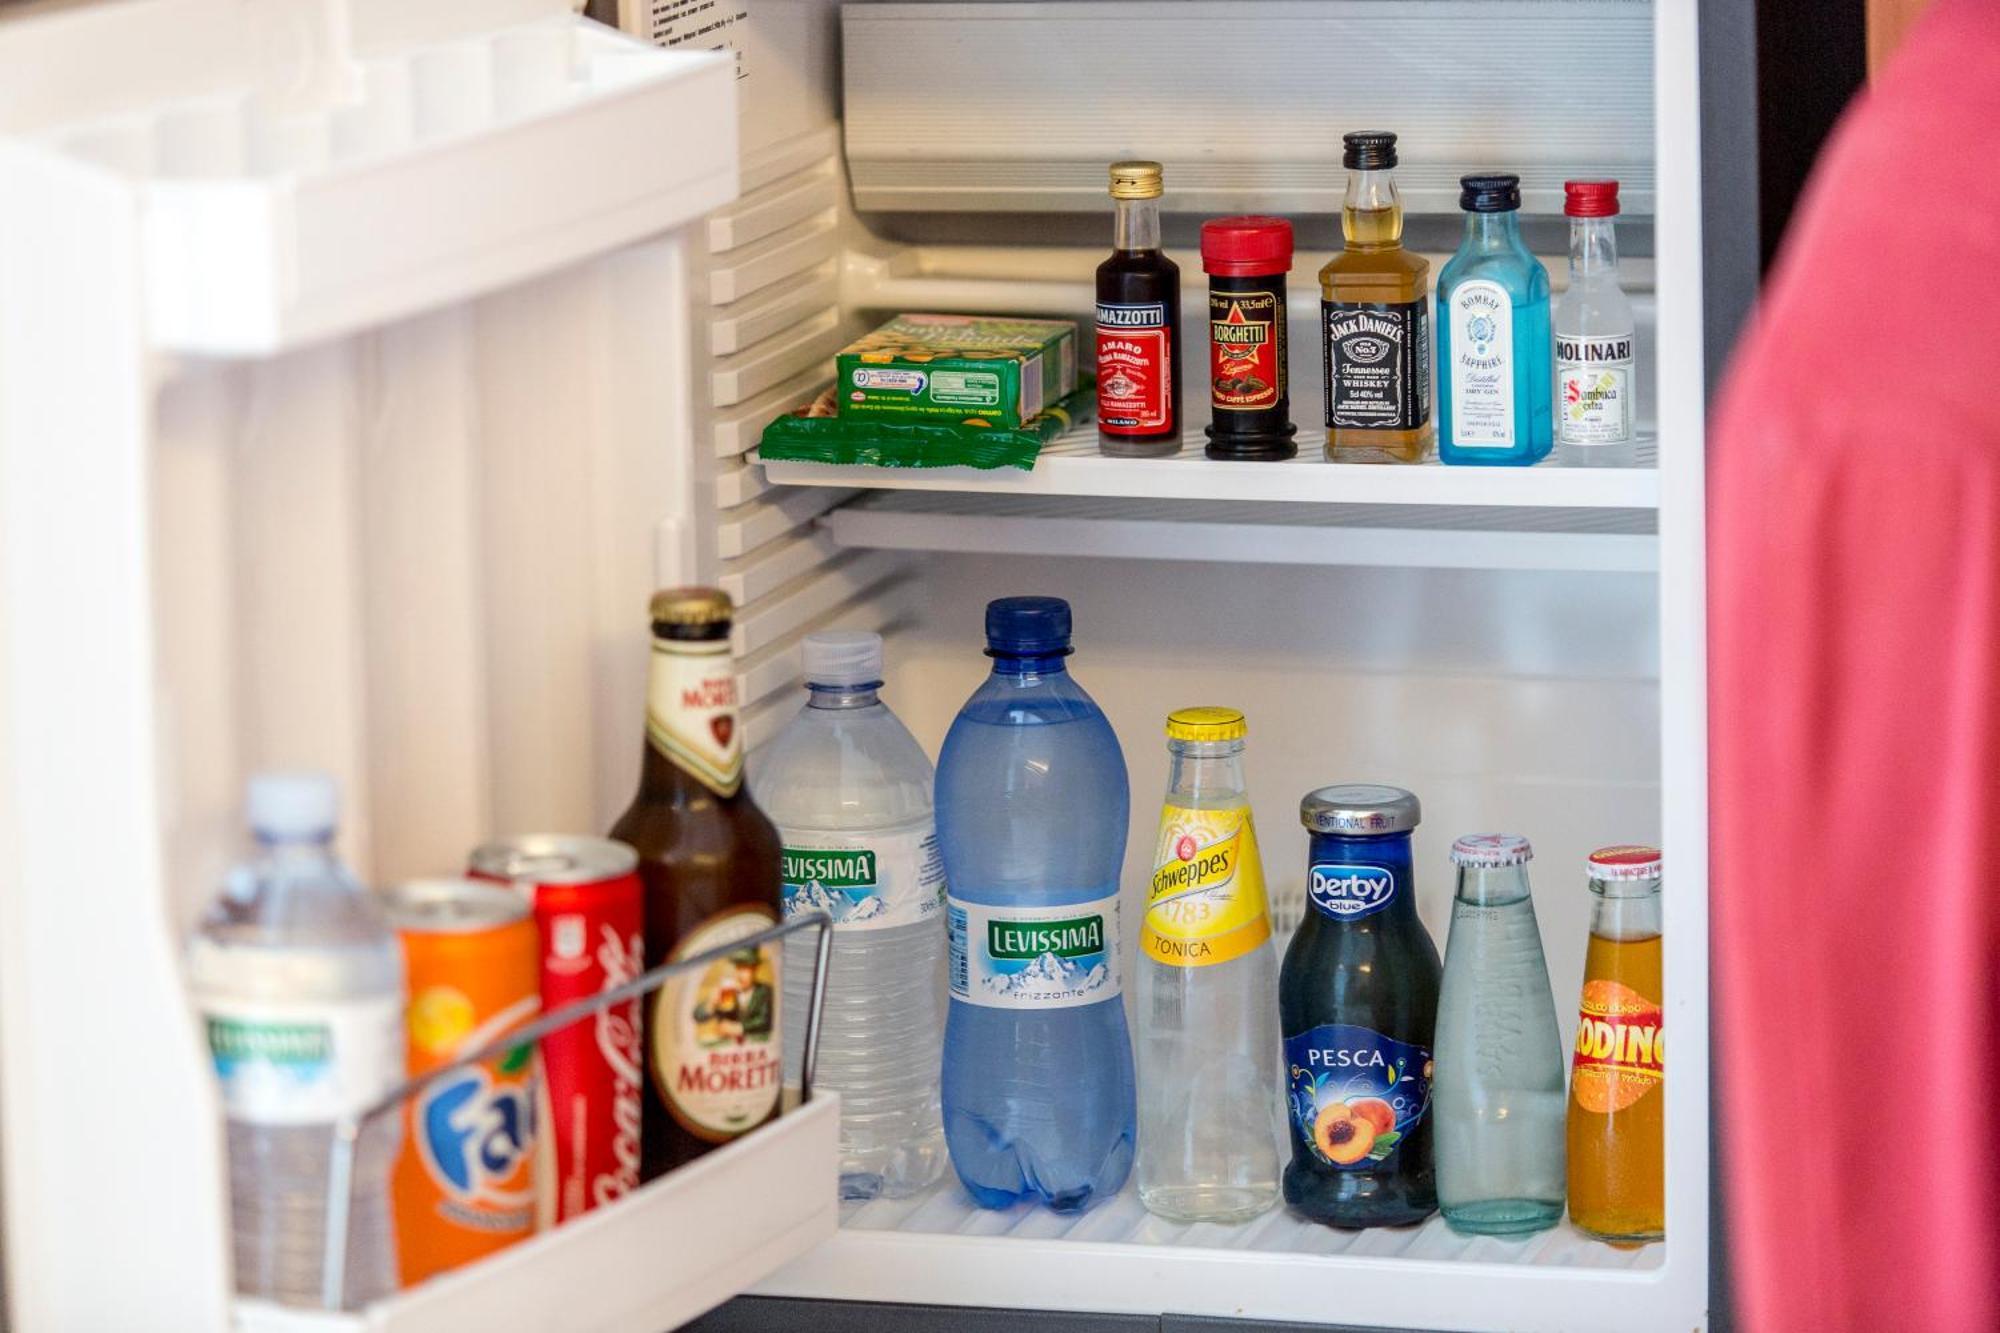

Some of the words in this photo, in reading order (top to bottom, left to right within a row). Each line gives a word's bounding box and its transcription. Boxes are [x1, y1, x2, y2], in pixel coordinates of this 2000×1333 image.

[1461, 294, 1499, 309] BOMBAY
[1214, 325, 1264, 342] BORGHETTI
[1330, 319, 1358, 341] JACK
[1358, 314, 1404, 342] DANIEL'S
[1102, 341, 1142, 354] AMARO
[1556, 340, 1630, 362] MOLINARI
[1342, 363, 1390, 375] Tennessee
[1460, 354, 1503, 369] SAPPHIRE
[1343, 380, 1390, 388] WHISKEY
[1568, 379, 1616, 402] Sambuca
[781, 855, 871, 880] EVISSIMA
[1152, 850, 1229, 899] Schweppes
[1312, 871, 1387, 900] Derby
[1165, 901, 1211, 924] 1783
[1329, 901, 1361, 910] blue
[994, 922, 1100, 953] LEVISSIMA
[1154, 936, 1212, 958] TONICA
[1013, 988, 1085, 1000] frizzante
[1577, 1017, 1664, 1064] ODIN
[1308, 1049, 1384, 1067] PESCA
